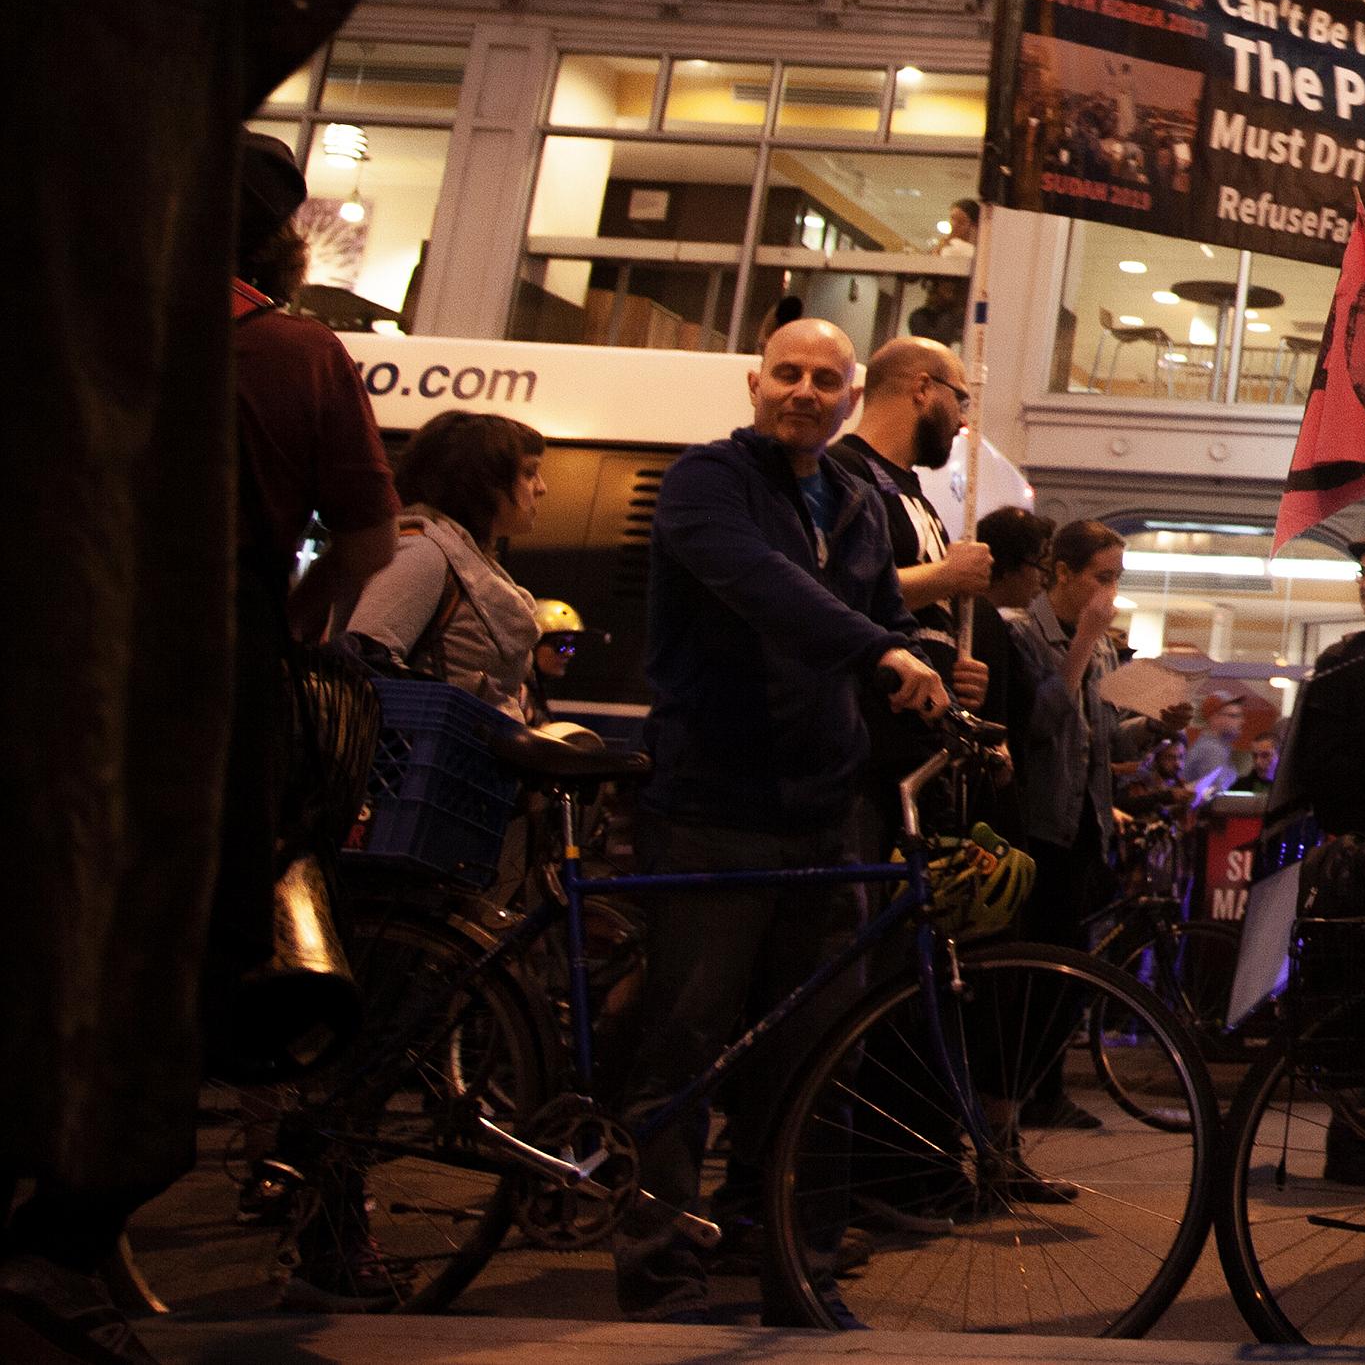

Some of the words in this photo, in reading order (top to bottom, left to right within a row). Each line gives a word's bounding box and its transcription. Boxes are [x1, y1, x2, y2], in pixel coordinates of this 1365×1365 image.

[1307, 8, 1349, 50] Be
[1223, 33, 1324, 112] The
[1208, 108, 1307, 169] Must
[354, 361, 538, 402] o.com
